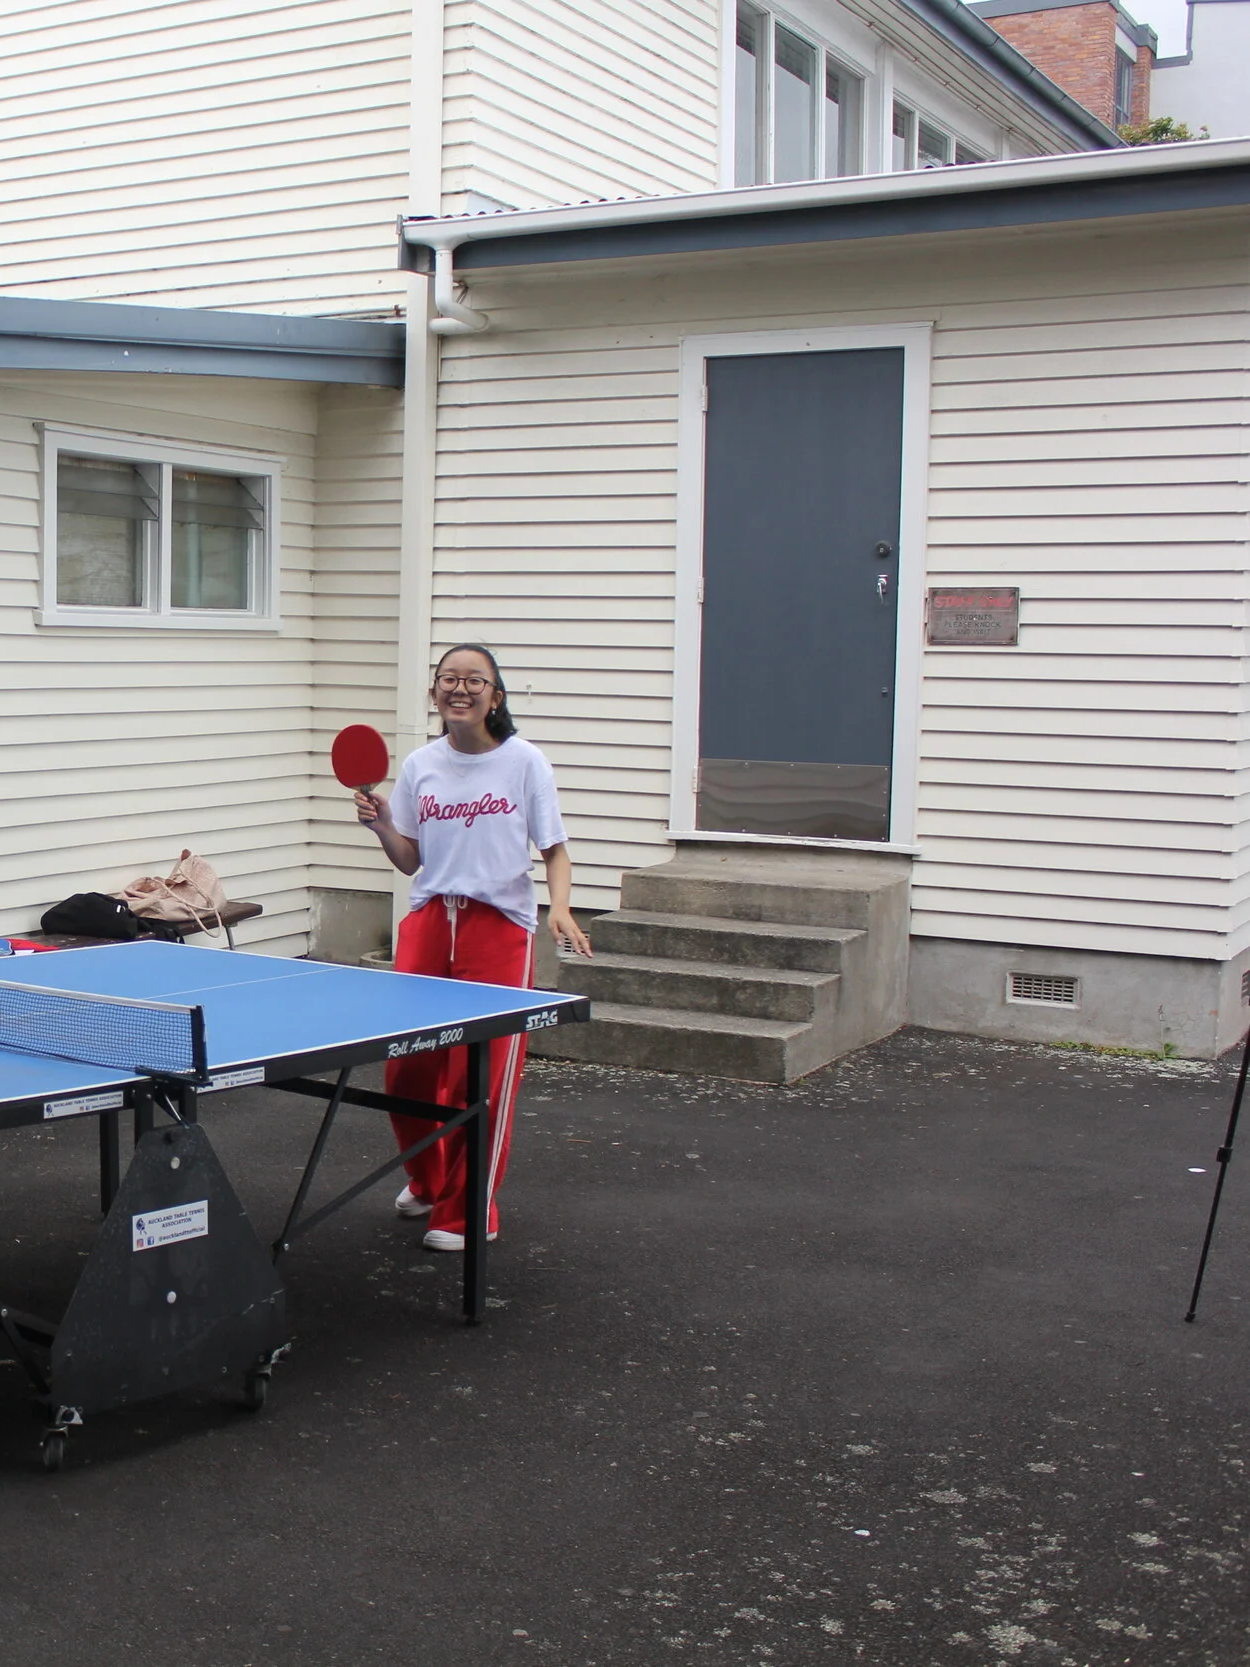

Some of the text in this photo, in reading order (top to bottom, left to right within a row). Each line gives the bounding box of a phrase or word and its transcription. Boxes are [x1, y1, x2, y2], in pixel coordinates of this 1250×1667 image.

[418, 792, 517, 828] Wrangler
[525, 1009, 558, 1031] STAG
[387, 1027, 464, 1059] Roll Away 2000
[148, 1207, 205, 1225] AUCKLAND TABLE TENNIS
[161, 1217, 193, 1228] ASSOCIATION
